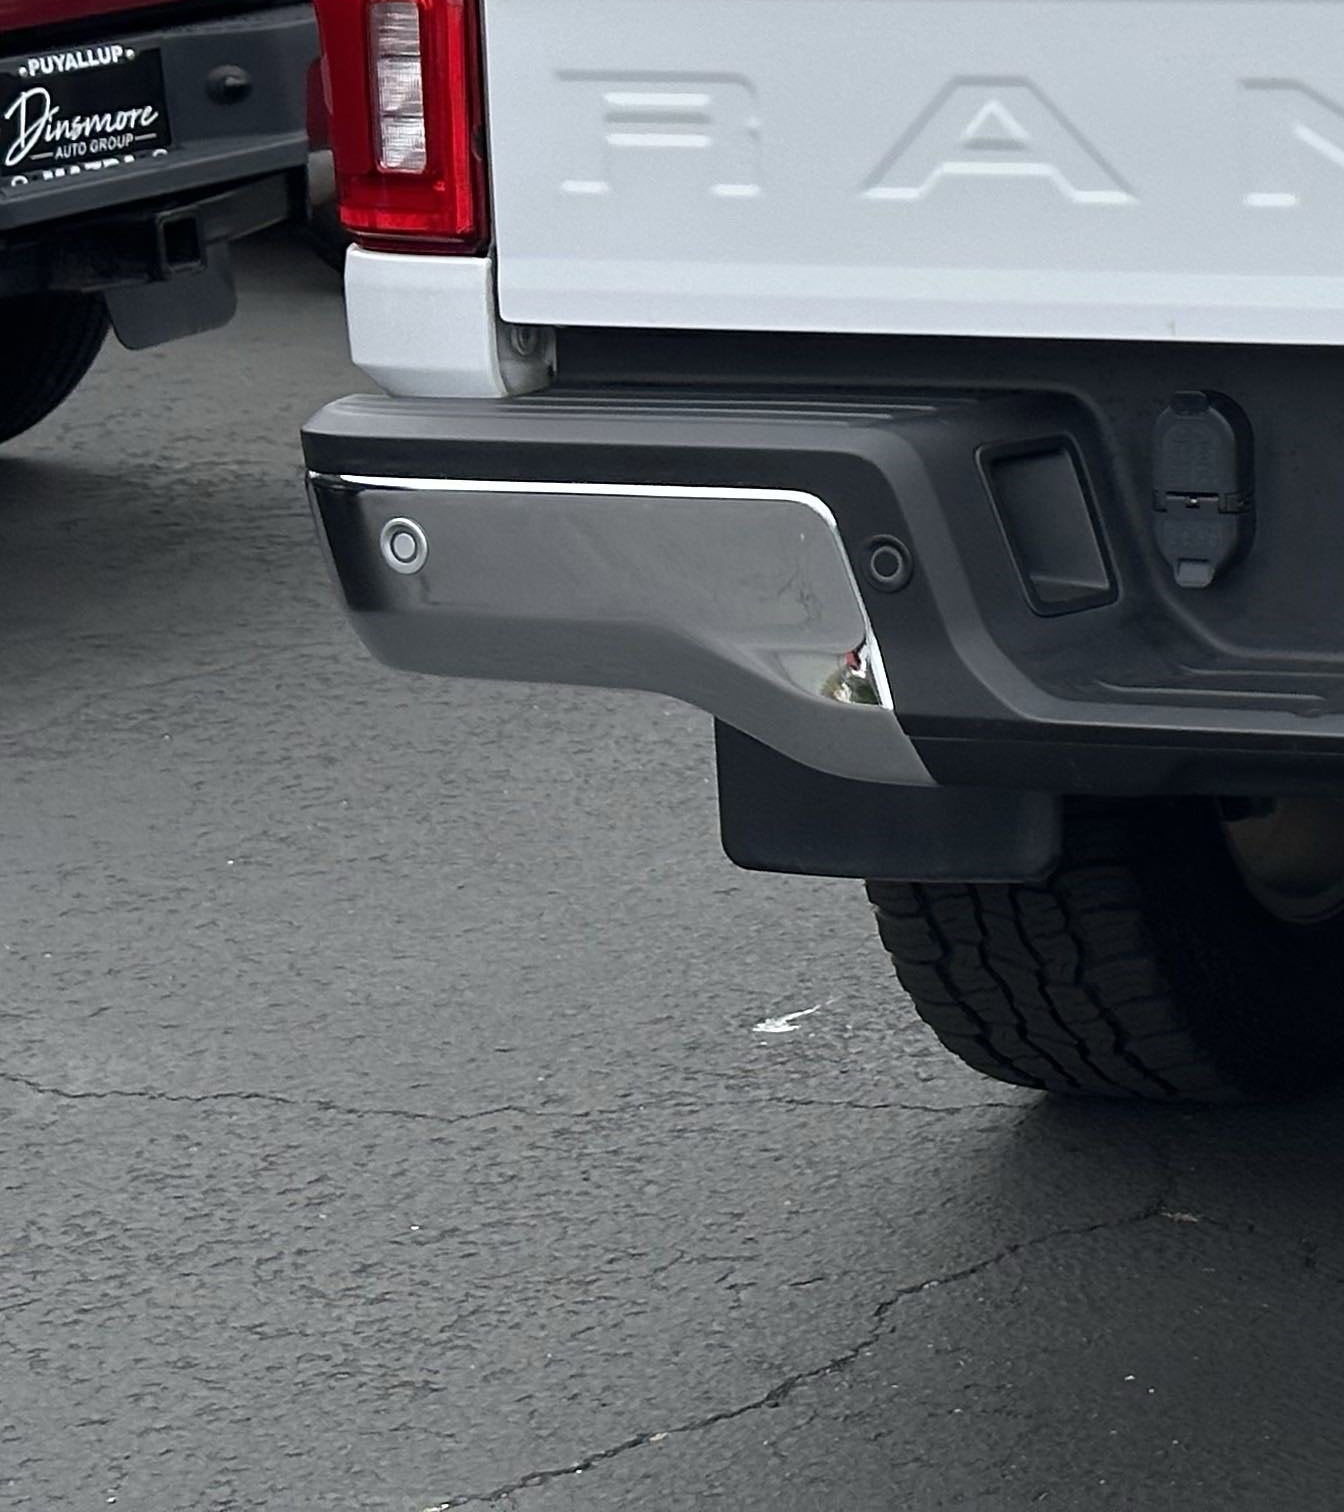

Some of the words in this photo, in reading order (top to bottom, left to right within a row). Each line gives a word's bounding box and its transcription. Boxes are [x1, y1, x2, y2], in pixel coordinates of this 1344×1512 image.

[28, 45, 123, 77] PUYALLUP
[4, 86, 159, 166] Dinsmore
[55, 142, 88, 160] AUTO
[90, 133, 134, 153] GROUP
